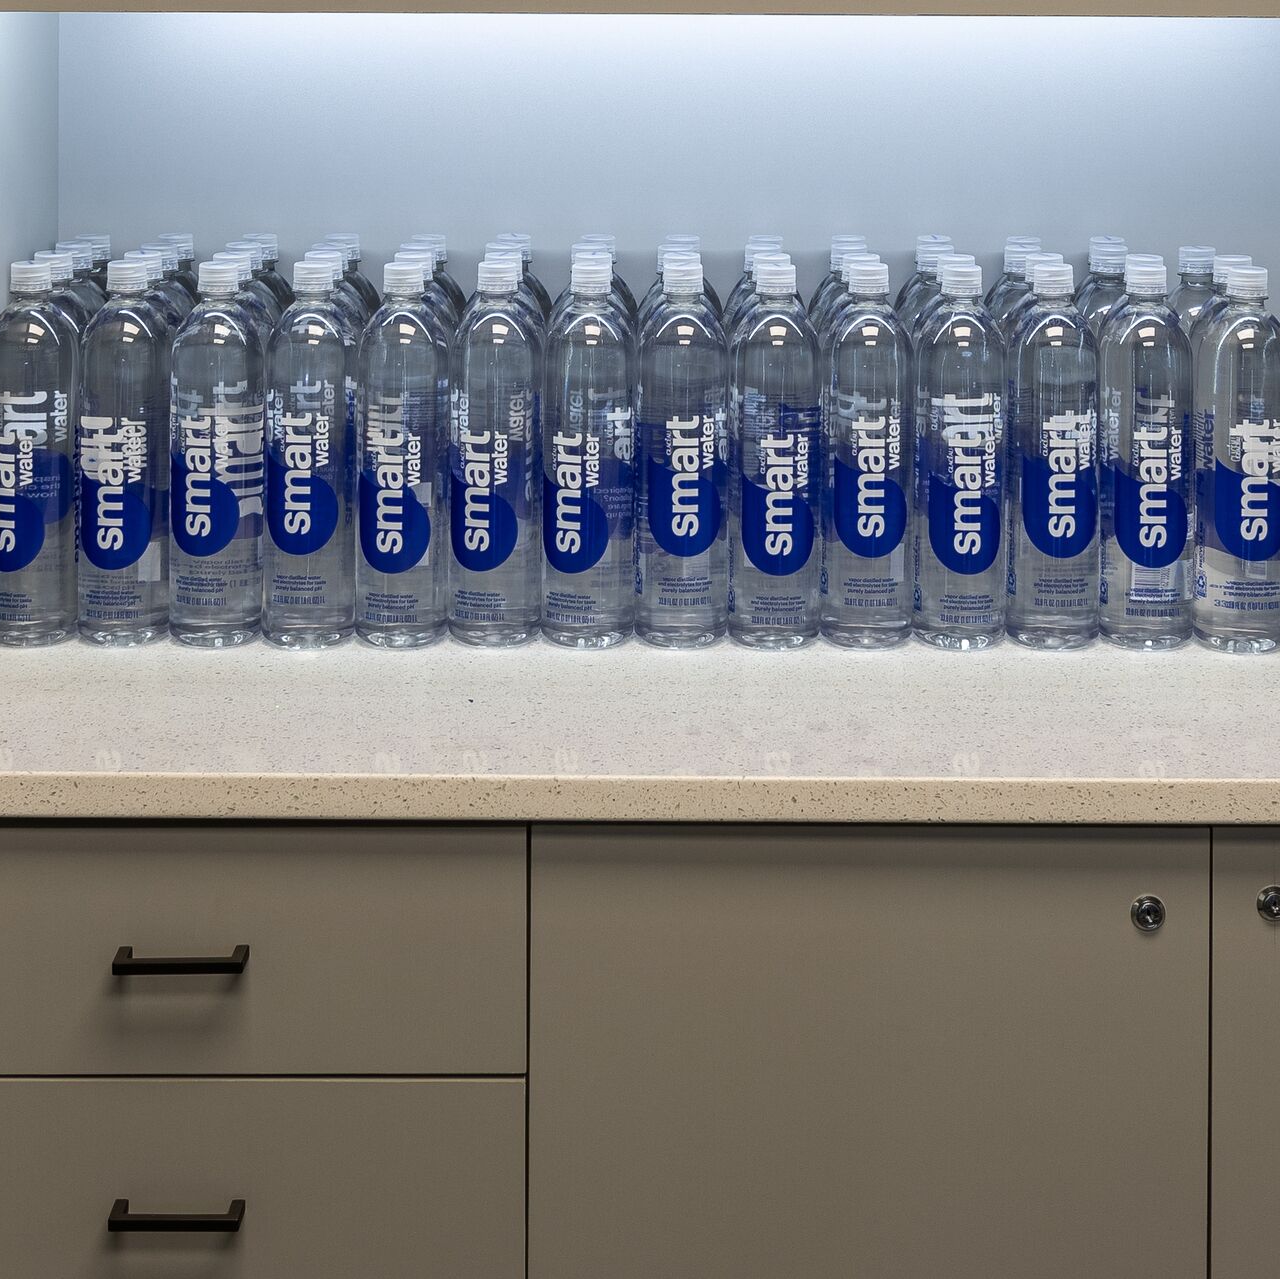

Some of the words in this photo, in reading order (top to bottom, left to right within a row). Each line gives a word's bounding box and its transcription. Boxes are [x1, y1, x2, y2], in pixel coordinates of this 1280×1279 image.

[20, 436, 33, 485] water
[215, 417, 229, 471] water
[315, 413, 329, 467] water
[407, 434, 421, 487] water
[493, 432, 508, 485] water
[585, 433, 600, 488] water
[702, 414, 715, 470] water
[796, 434, 809, 489] water
[886, 416, 900, 471] water
[1078, 418, 1092, 471] water
[1171, 426, 1182, 481] water
[184, 415, 212, 537] smart
[283, 411, 313, 536] smart
[375, 430, 404, 555] smart
[464, 430, 491, 552] smart
[555, 431, 583, 554] smart
[666, 415, 700, 538] smart
[760, 434, 795, 557] smart
[850, 416, 885, 538] smart
[1043, 410, 1075, 538] smart
[1133, 425, 1168, 548] smart
